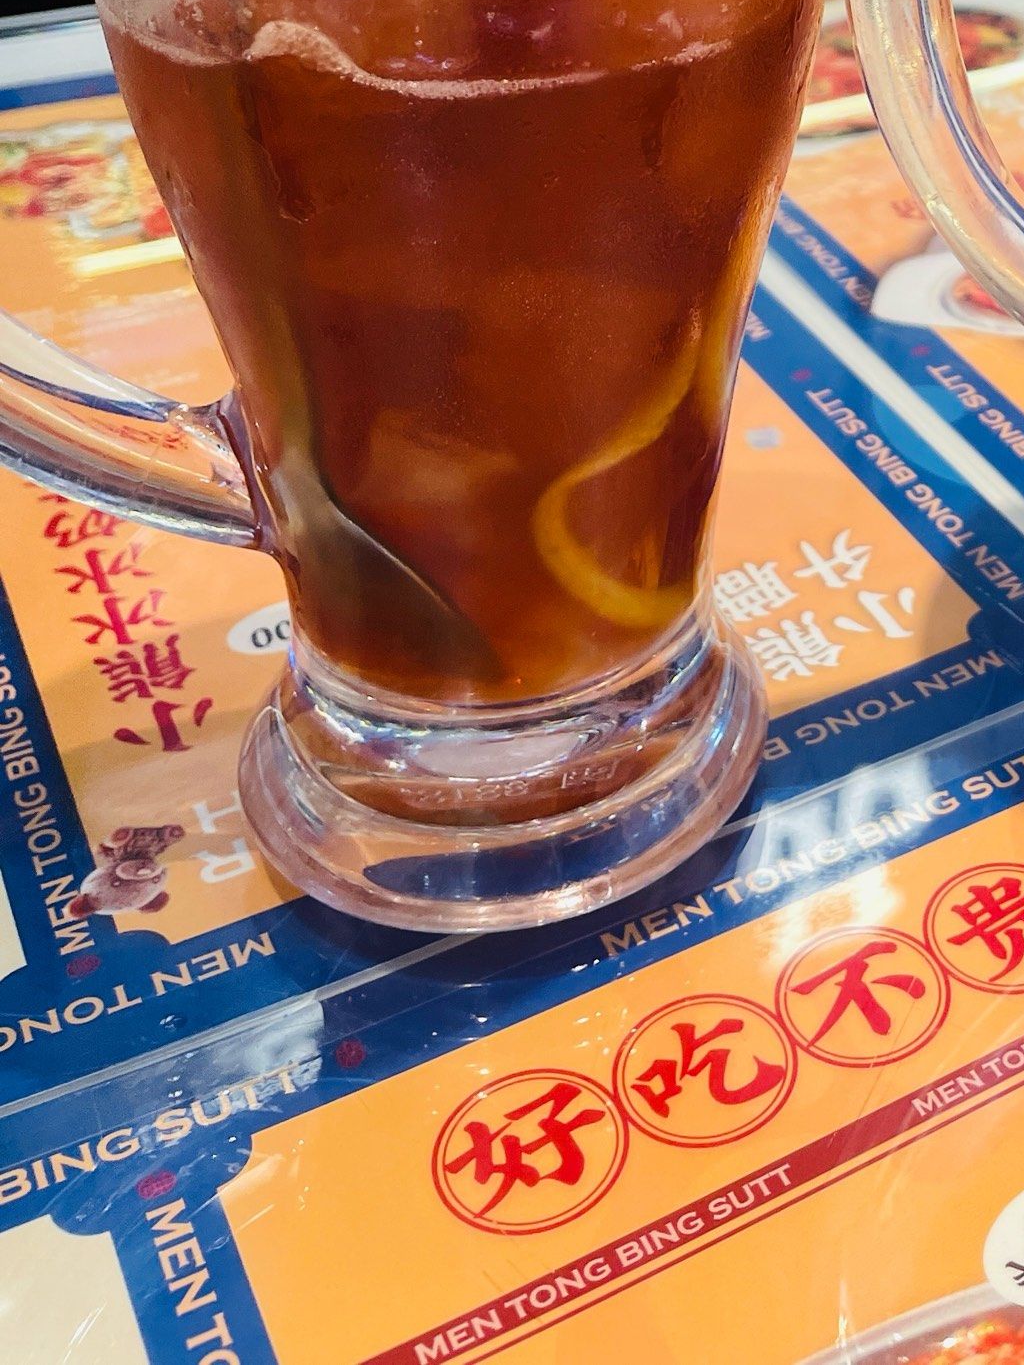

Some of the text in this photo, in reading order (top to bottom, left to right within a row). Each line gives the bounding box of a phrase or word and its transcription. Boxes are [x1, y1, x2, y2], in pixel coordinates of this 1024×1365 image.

[805, 388, 869, 437] SUTT
[925, 364, 989, 410] SUTT
[854, 434, 919, 487] BING
[904, 483, 974, 549] TONG
[40, 494, 213, 752] 小熊冰冰奶
[793, 649, 1006, 745] MEN TONG
[13, 782, 69, 876] TONG
[603, 894, 716, 957] MEN
[713, 833, 848, 904] TONG
[849, 788, 961, 849] BING
[149, 931, 277, 997] MEN
[911, 1069, 985, 1118] MEN
[0, 1126, 142, 1207] BING
[145, 1196, 218, 1318] MEN
[413, 1163, 793, 1365] MEN TONG BING SUTT
